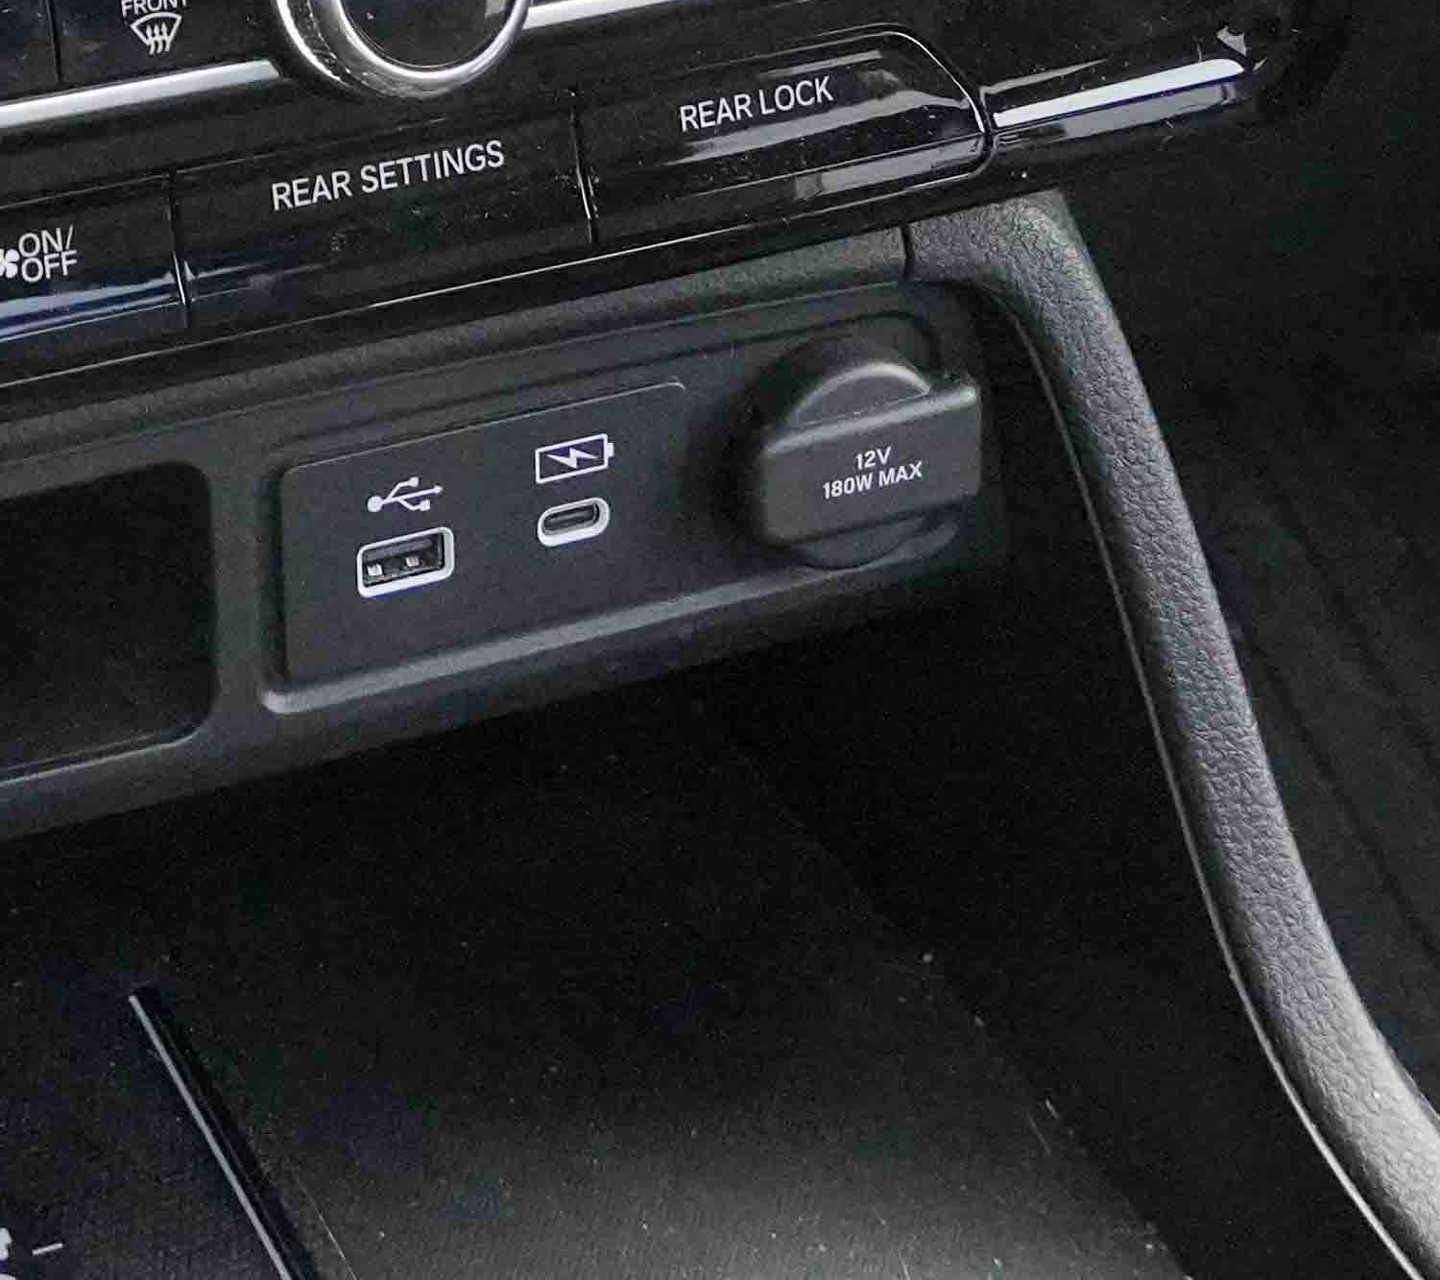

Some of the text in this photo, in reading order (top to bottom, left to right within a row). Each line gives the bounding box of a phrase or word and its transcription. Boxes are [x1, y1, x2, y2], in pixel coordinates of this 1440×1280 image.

[680, 75, 834, 132] REAR LOCK
[272, 140, 505, 211] REAR SETTINGS
[22, 248, 77, 283] OFF
[856, 446, 891, 471] 12V
[822, 461, 922, 499] 180W MAX
